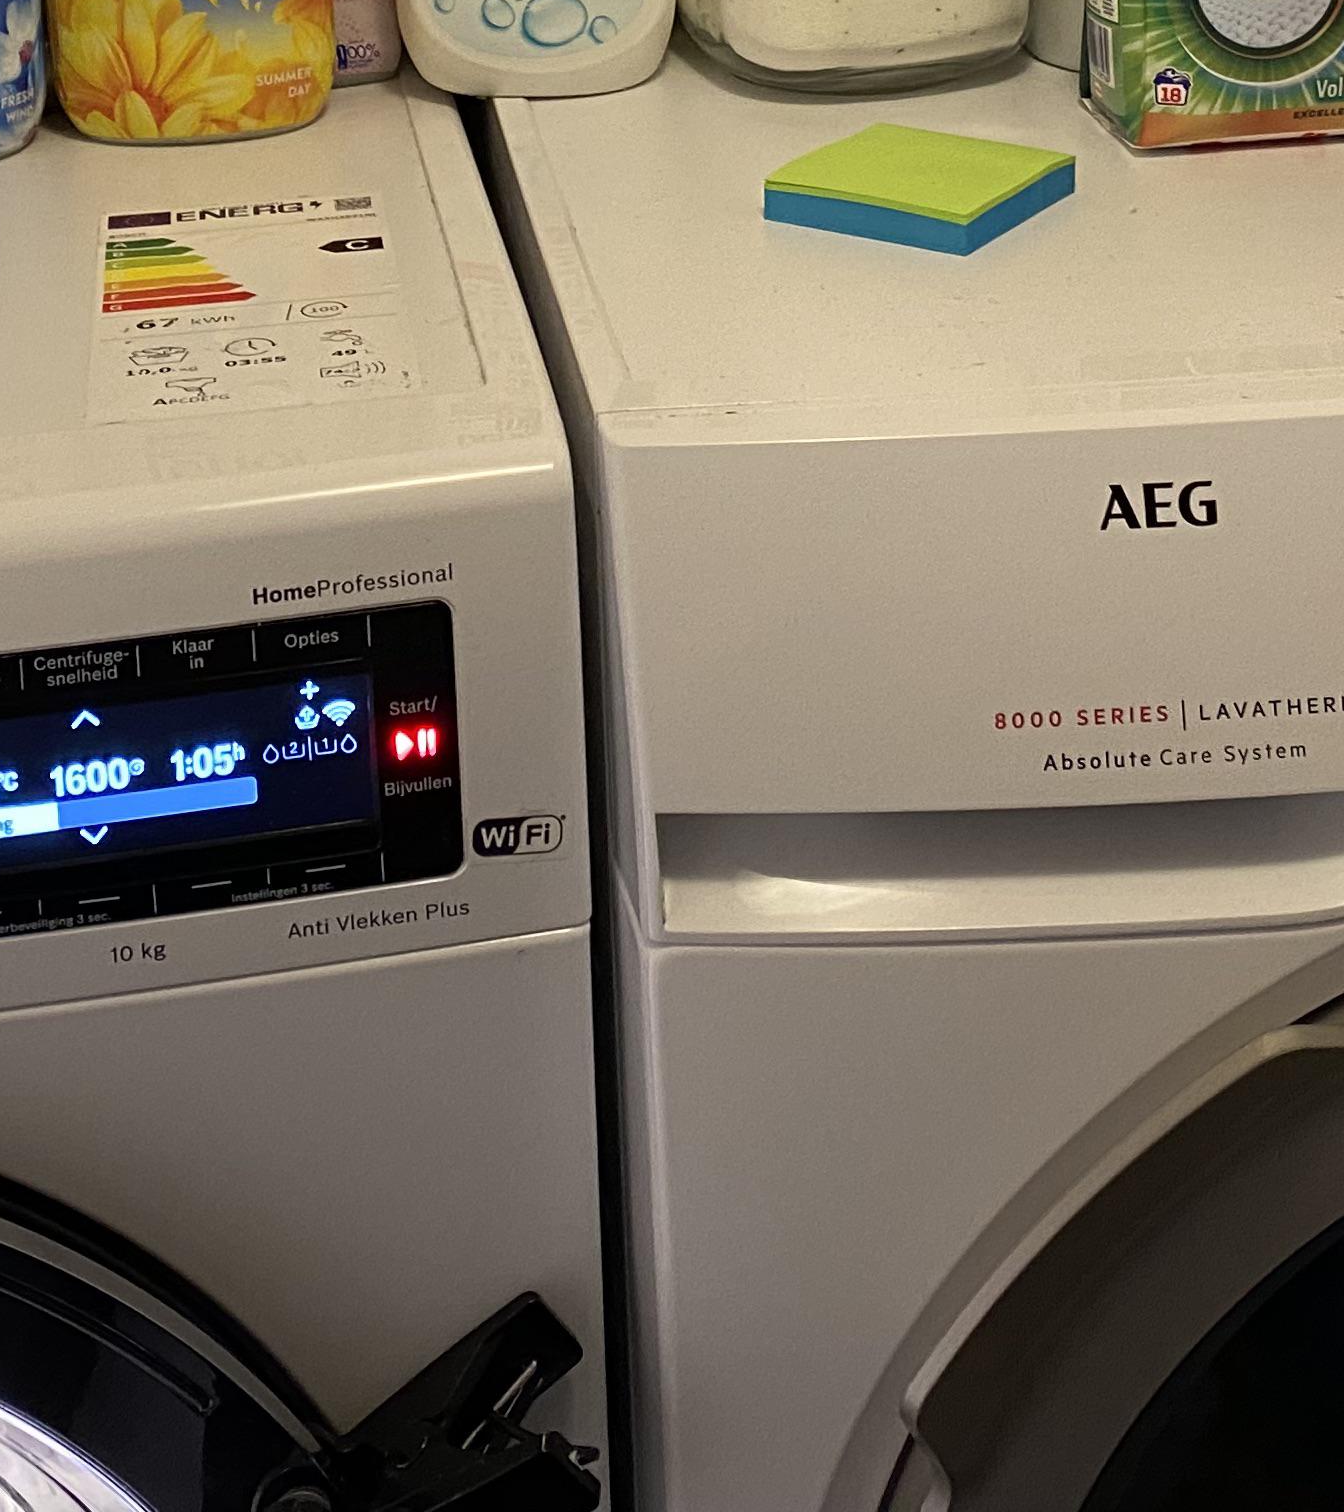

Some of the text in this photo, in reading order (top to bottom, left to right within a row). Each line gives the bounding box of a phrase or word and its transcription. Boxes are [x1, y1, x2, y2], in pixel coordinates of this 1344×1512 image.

[256, 67, 312, 88] SUMMER
[288, 82, 311, 97] DAY
[1161, 88, 1181, 103] 18
[176, 201, 304, 224] ENERG
[346, 238, 369, 250] C
[190, 314, 236, 327] kWh
[1100, 480, 1219, 531] AEG
[251, 563, 455, 606] HomeProfessional
[33, 649, 130, 675] Centrifuge-
[171, 635, 215, 655] Klaar
[284, 629, 339, 651] Opties
[46, 653, 204, 688] snelheid in
[388, 695, 438, 717] Start/
[994, 710, 1063, 730] 8000
[1076, 705, 1169, 726] SERIES
[1043, 743, 1307, 772] Absolute Care System
[383, 773, 453, 799] Bijvullen
[87, 881, 334, 924] sec. Instellingen sec.
[287, 899, 470, 940] Anti Vlekken Plus
[110, 942, 166, 963] 10 kg
